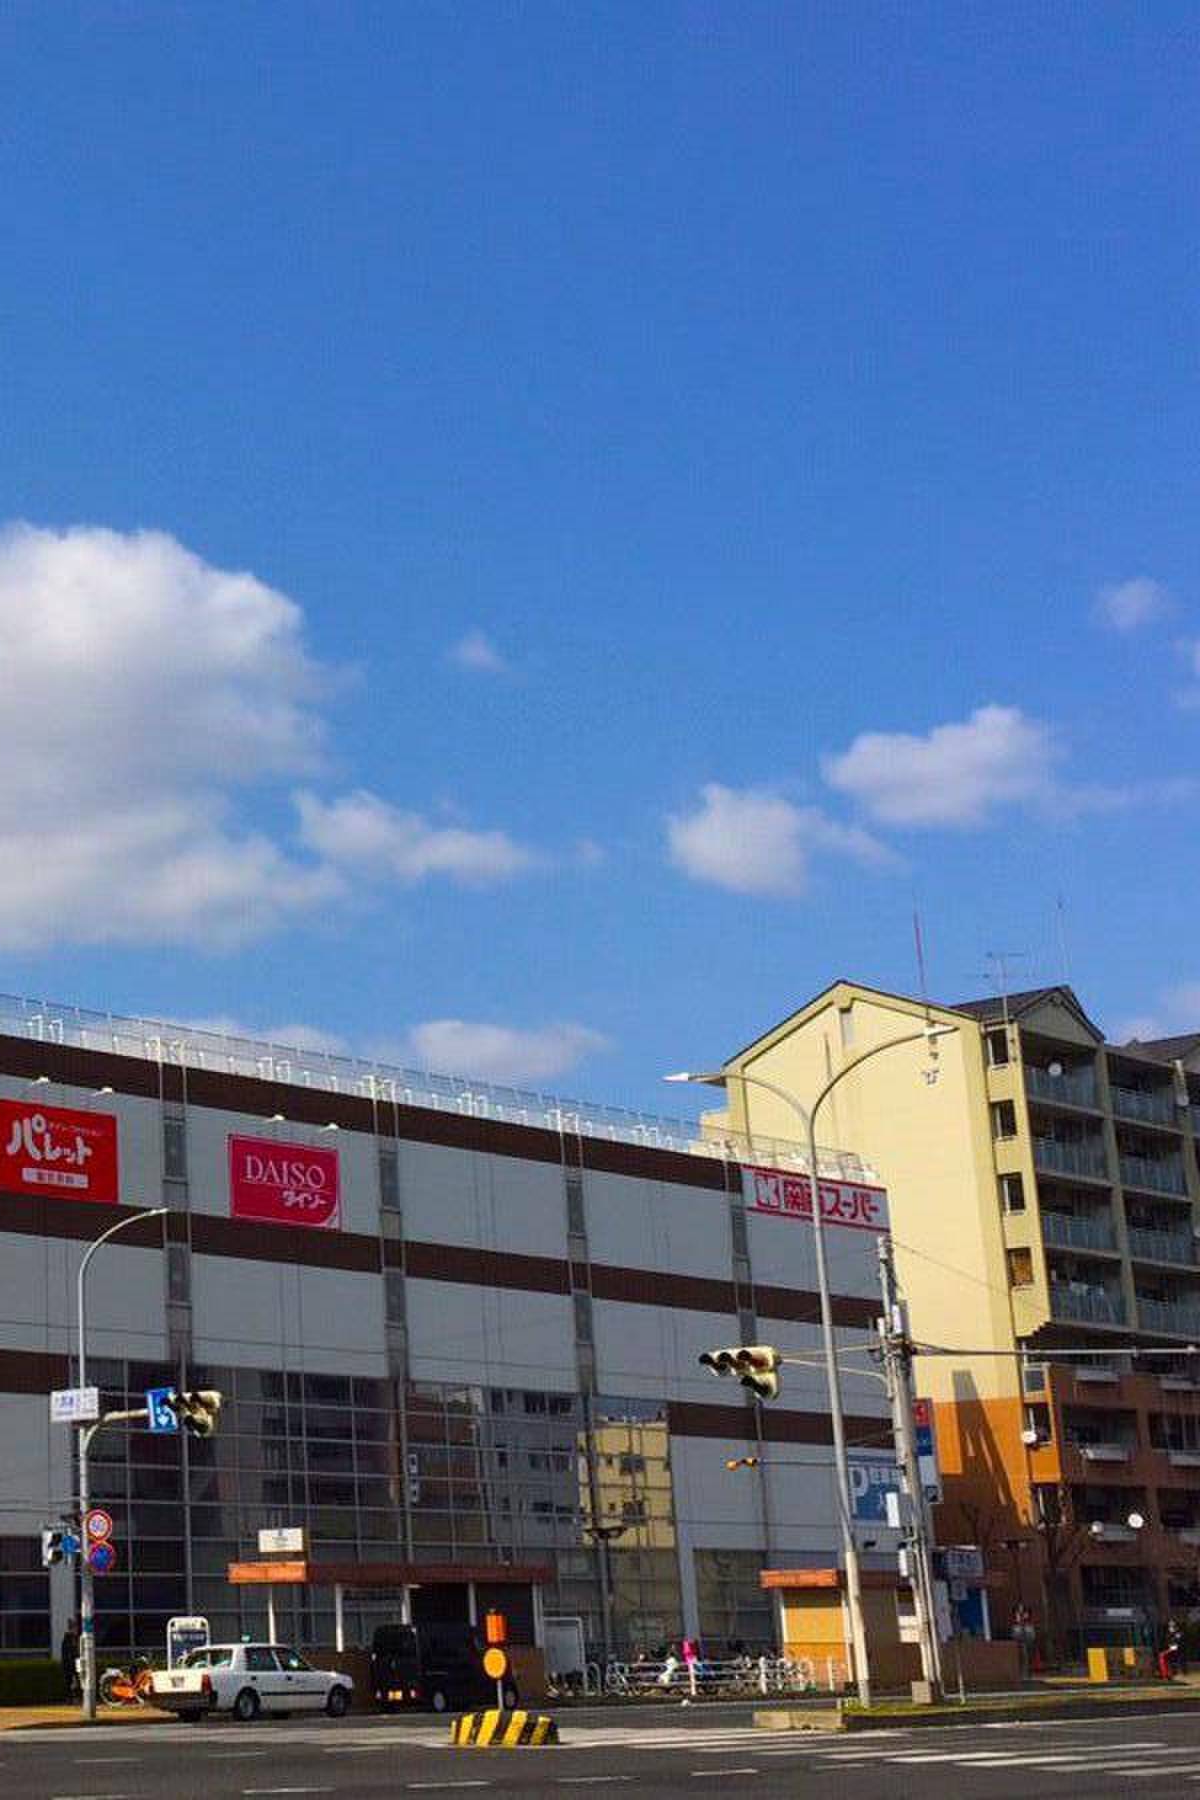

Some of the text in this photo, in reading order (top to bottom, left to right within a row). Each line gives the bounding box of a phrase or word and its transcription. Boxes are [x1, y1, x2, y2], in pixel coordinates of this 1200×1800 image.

[6, 1112, 93, 1167] パレット
[244, 1154, 327, 1189] DAISO
